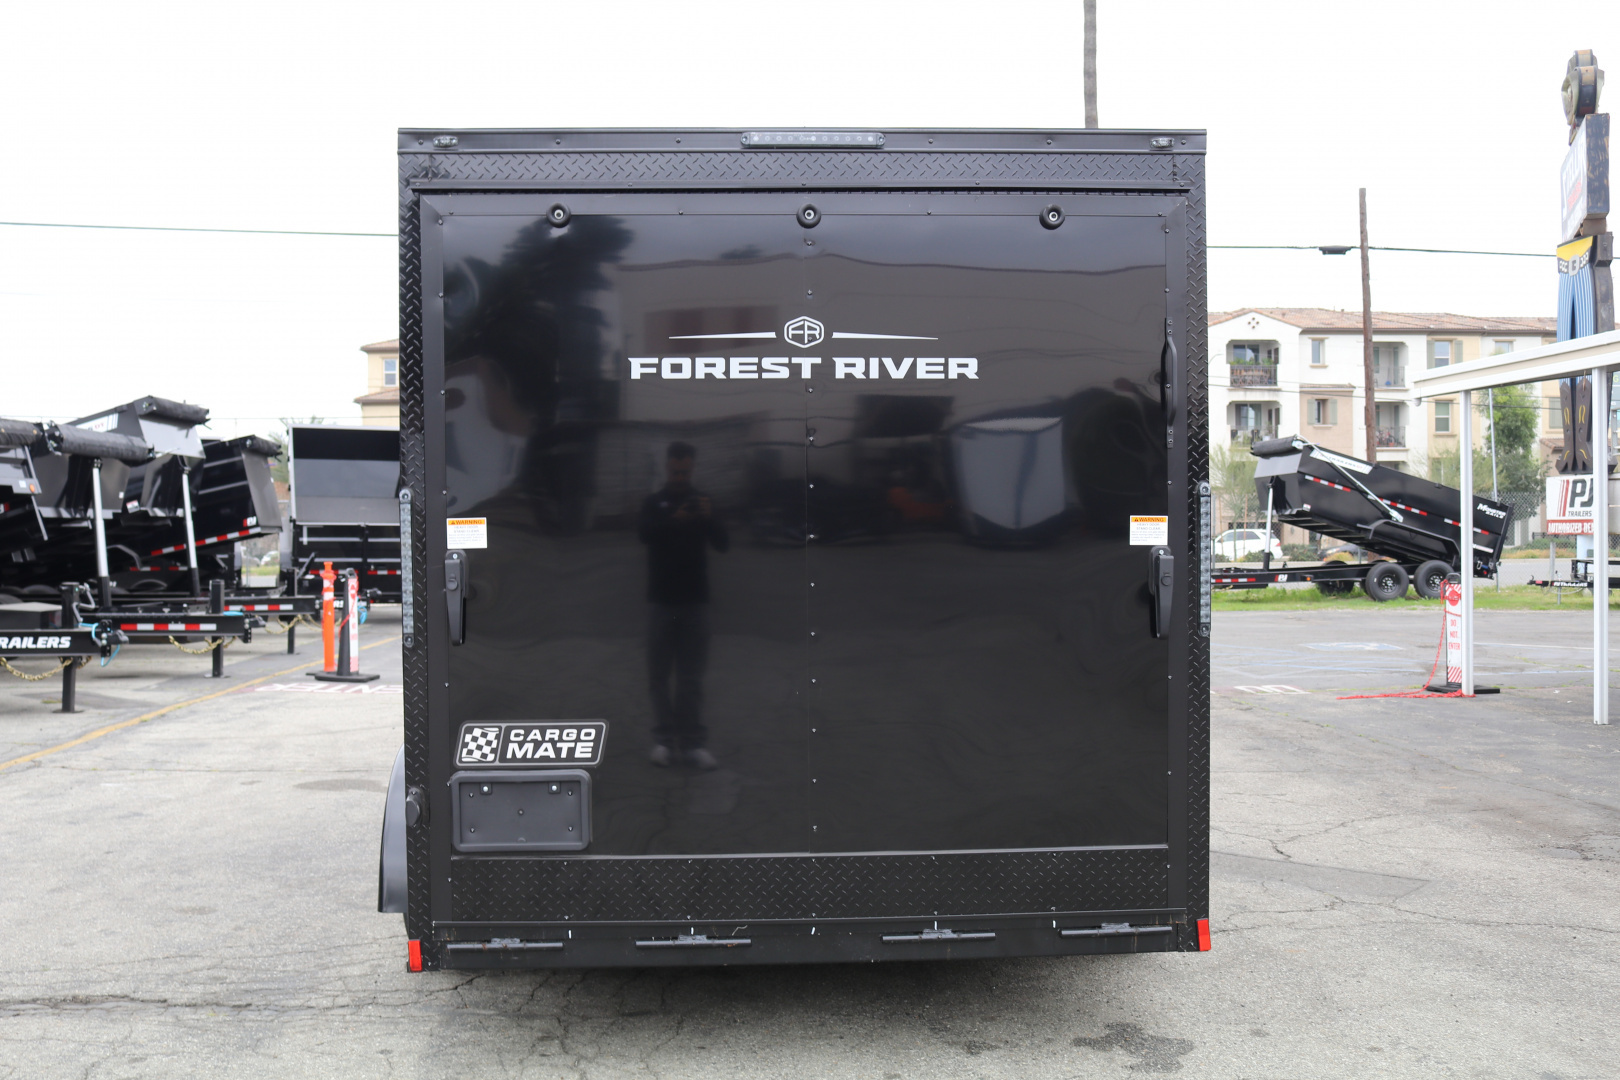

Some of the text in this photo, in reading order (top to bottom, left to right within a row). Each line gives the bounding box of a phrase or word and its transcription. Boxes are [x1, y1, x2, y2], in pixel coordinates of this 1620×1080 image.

[628, 356, 979, 380] FOREST RIVER
[1569, 478, 1593, 508] PJ
[1548, 522, 1582, 533] AUTHORIZED
[1450, 619, 1457, 627] DO
[1449, 631, 1459, 639] NOT
[1448, 642, 1461, 651] ENTER
[509, 728, 596, 742] CARGO
[506, 741, 594, 759] MATE
